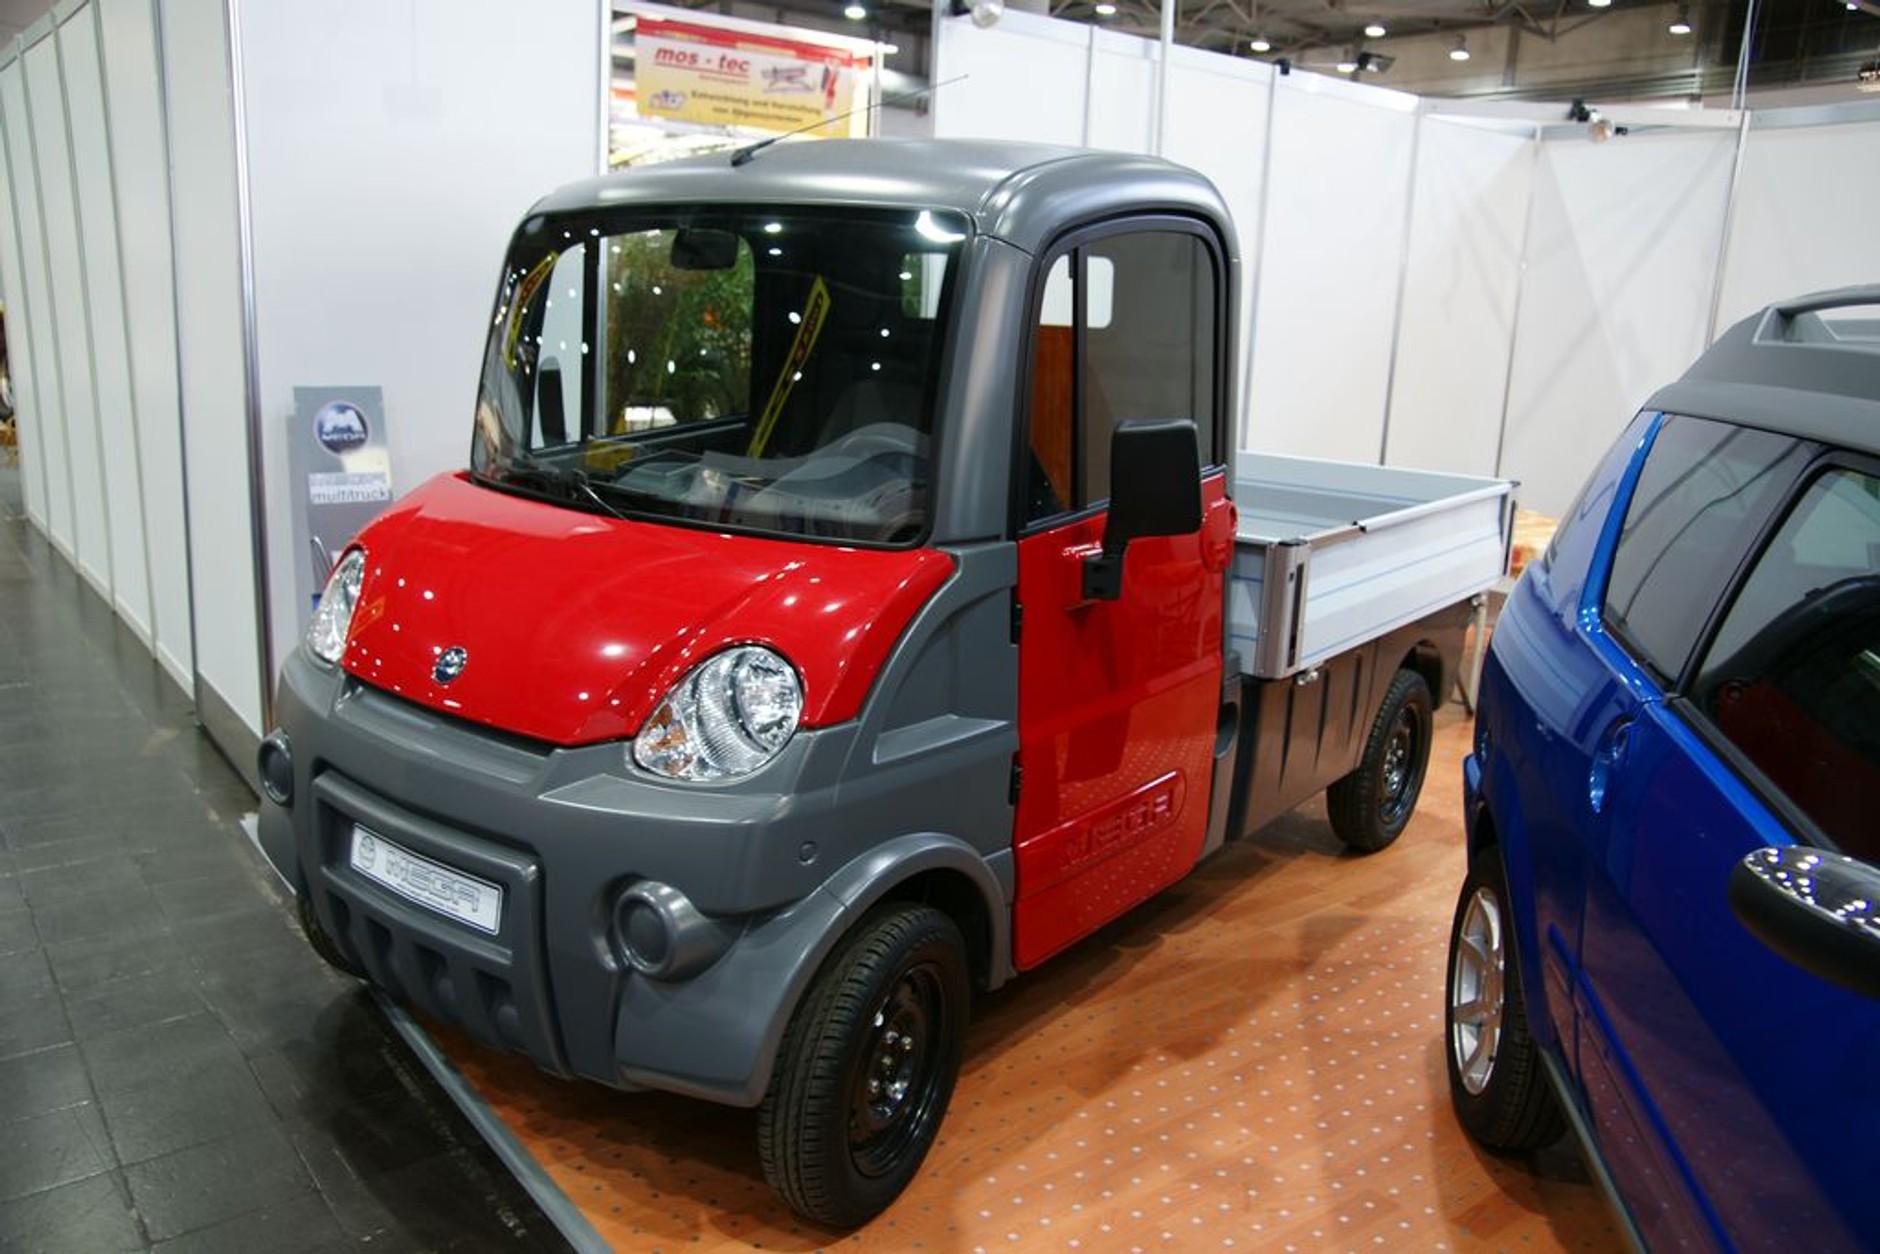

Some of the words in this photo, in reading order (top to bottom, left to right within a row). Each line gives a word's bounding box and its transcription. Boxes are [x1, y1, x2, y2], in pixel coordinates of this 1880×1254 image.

[654, 46, 699, 66] mos
[719, 53, 751, 73] tec
[311, 488, 387, 502] multitruck
[385, 849, 482, 913] MEGA
